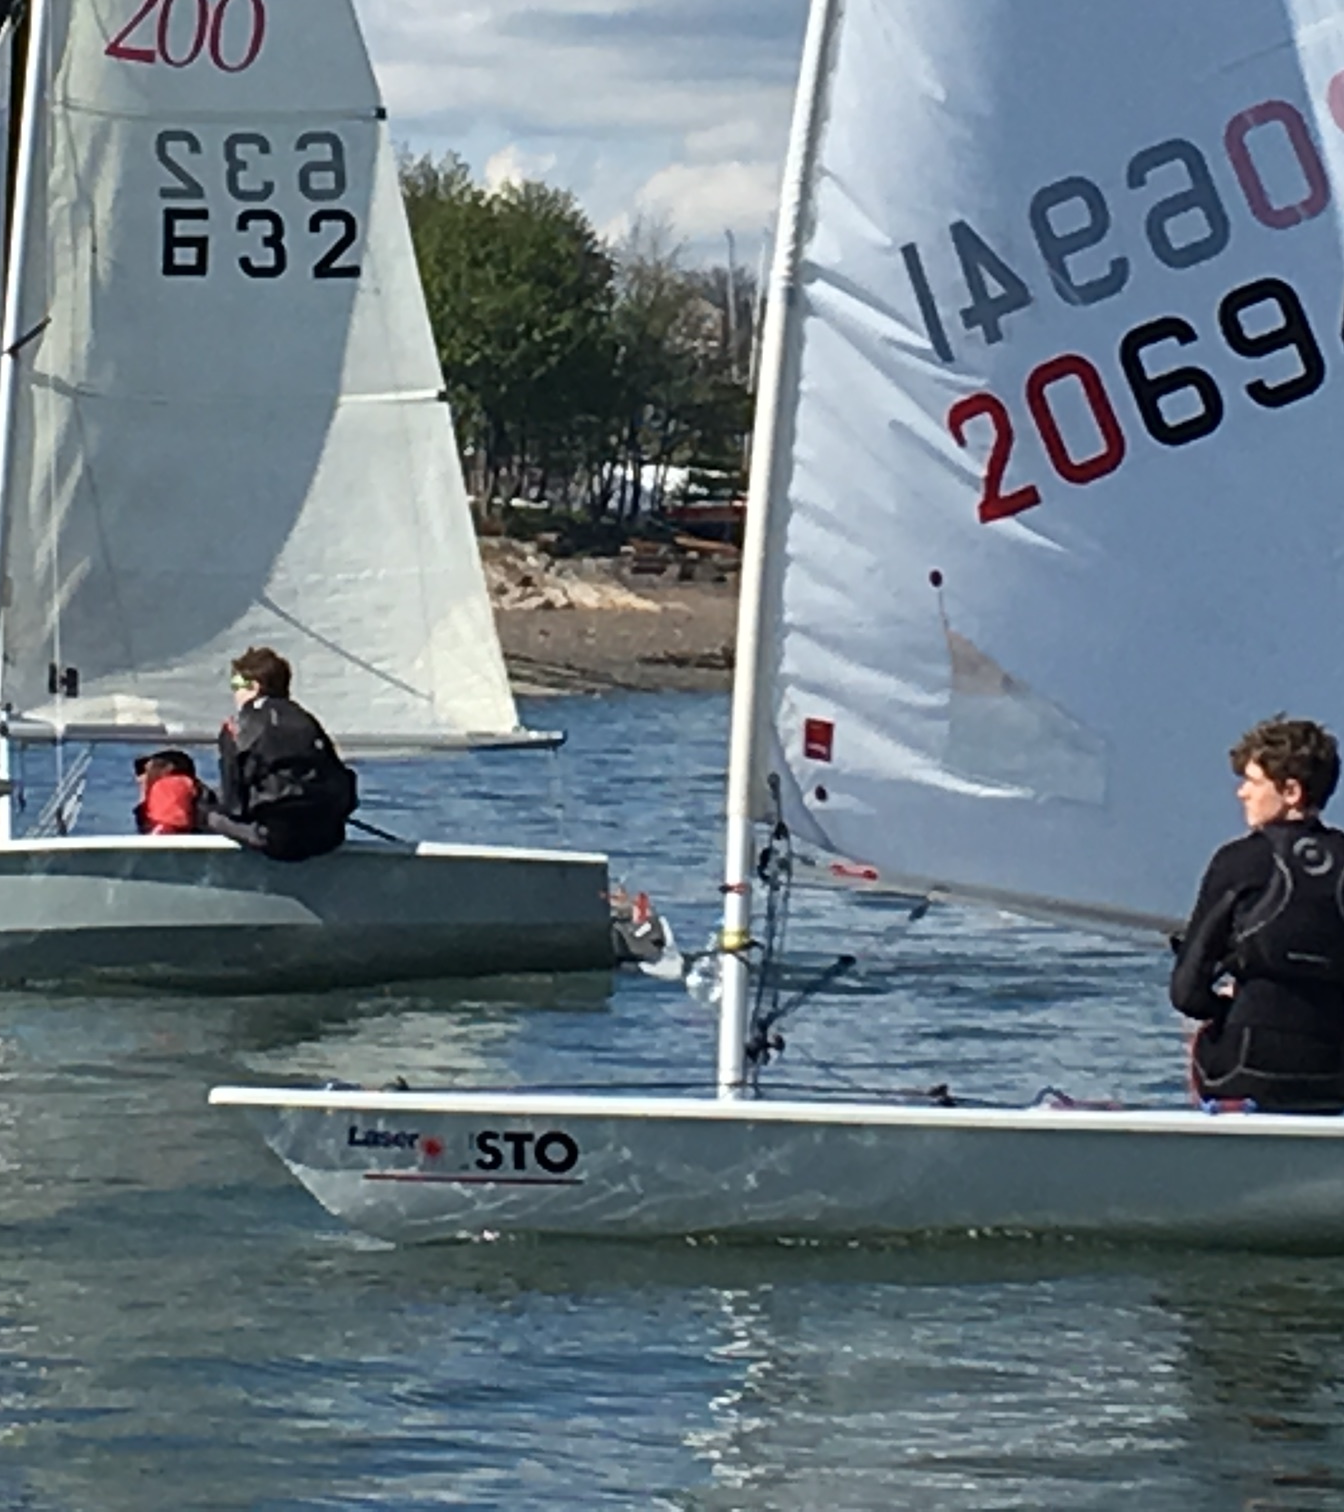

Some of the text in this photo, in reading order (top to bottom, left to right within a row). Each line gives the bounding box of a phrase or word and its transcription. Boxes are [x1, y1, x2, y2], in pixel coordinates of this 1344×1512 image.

[161, 207, 362, 279] 632
[347, 1125, 420, 1149] Laser
[475, 1131, 579, 1174] STO
